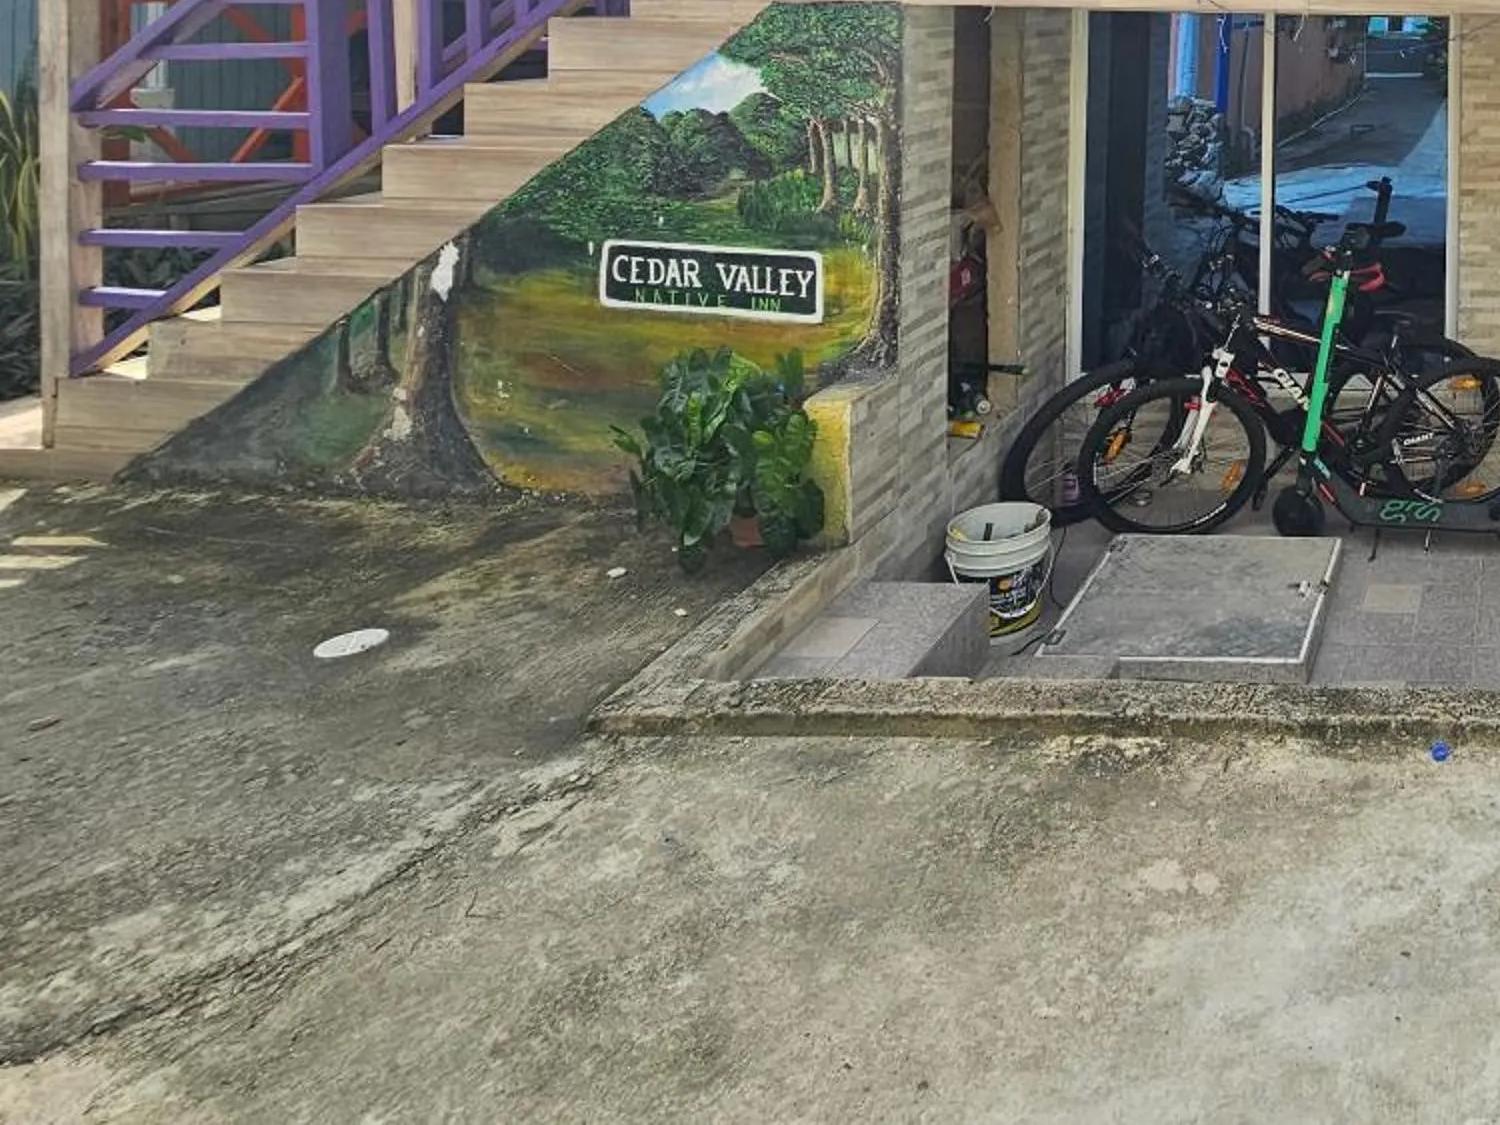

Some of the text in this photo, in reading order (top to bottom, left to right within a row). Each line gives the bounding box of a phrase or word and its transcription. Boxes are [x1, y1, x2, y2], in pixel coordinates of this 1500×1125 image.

[612, 254, 815, 298] CEDAR VALLEY
[635, 287, 782, 312] NATIVE INN
[1273, 368, 1311, 411] GIAN
